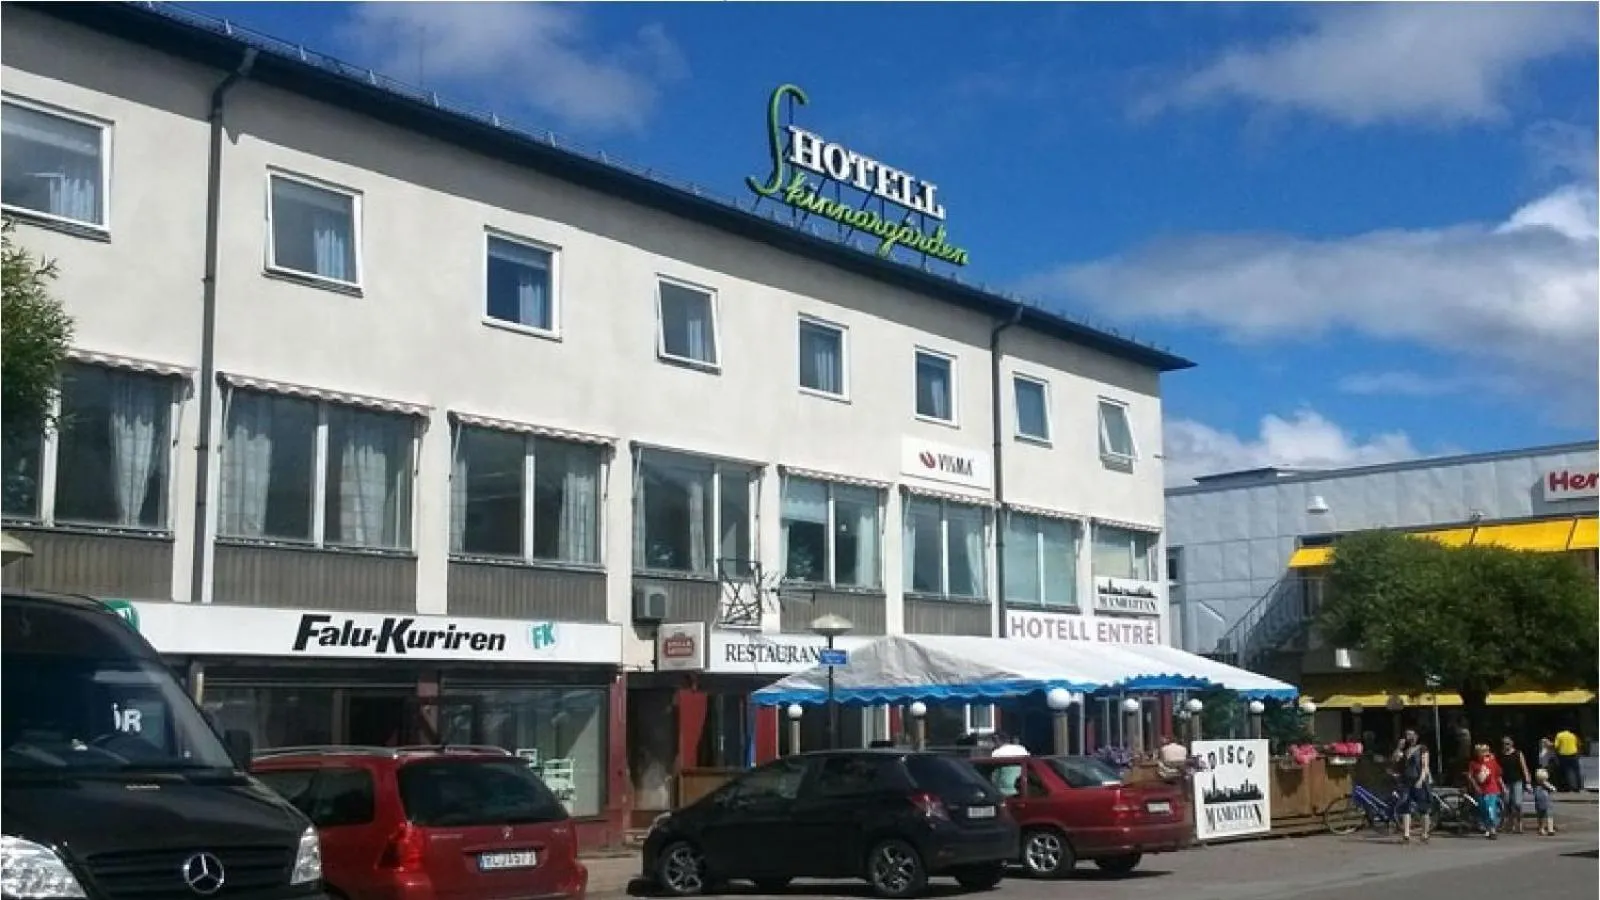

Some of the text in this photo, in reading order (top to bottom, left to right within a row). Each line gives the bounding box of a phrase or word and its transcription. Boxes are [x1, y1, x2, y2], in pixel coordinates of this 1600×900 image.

[745, 83, 968, 265] Skinnargården
[787, 125, 946, 219] HOTELL
[292, 613, 507, 654] Falu-Kuriren
[1011, 615, 1155, 645] HOTELL ENTRÉ
[724, 643, 822, 665] RESTAURAN
[1208, 745, 1255, 769] DISCO
